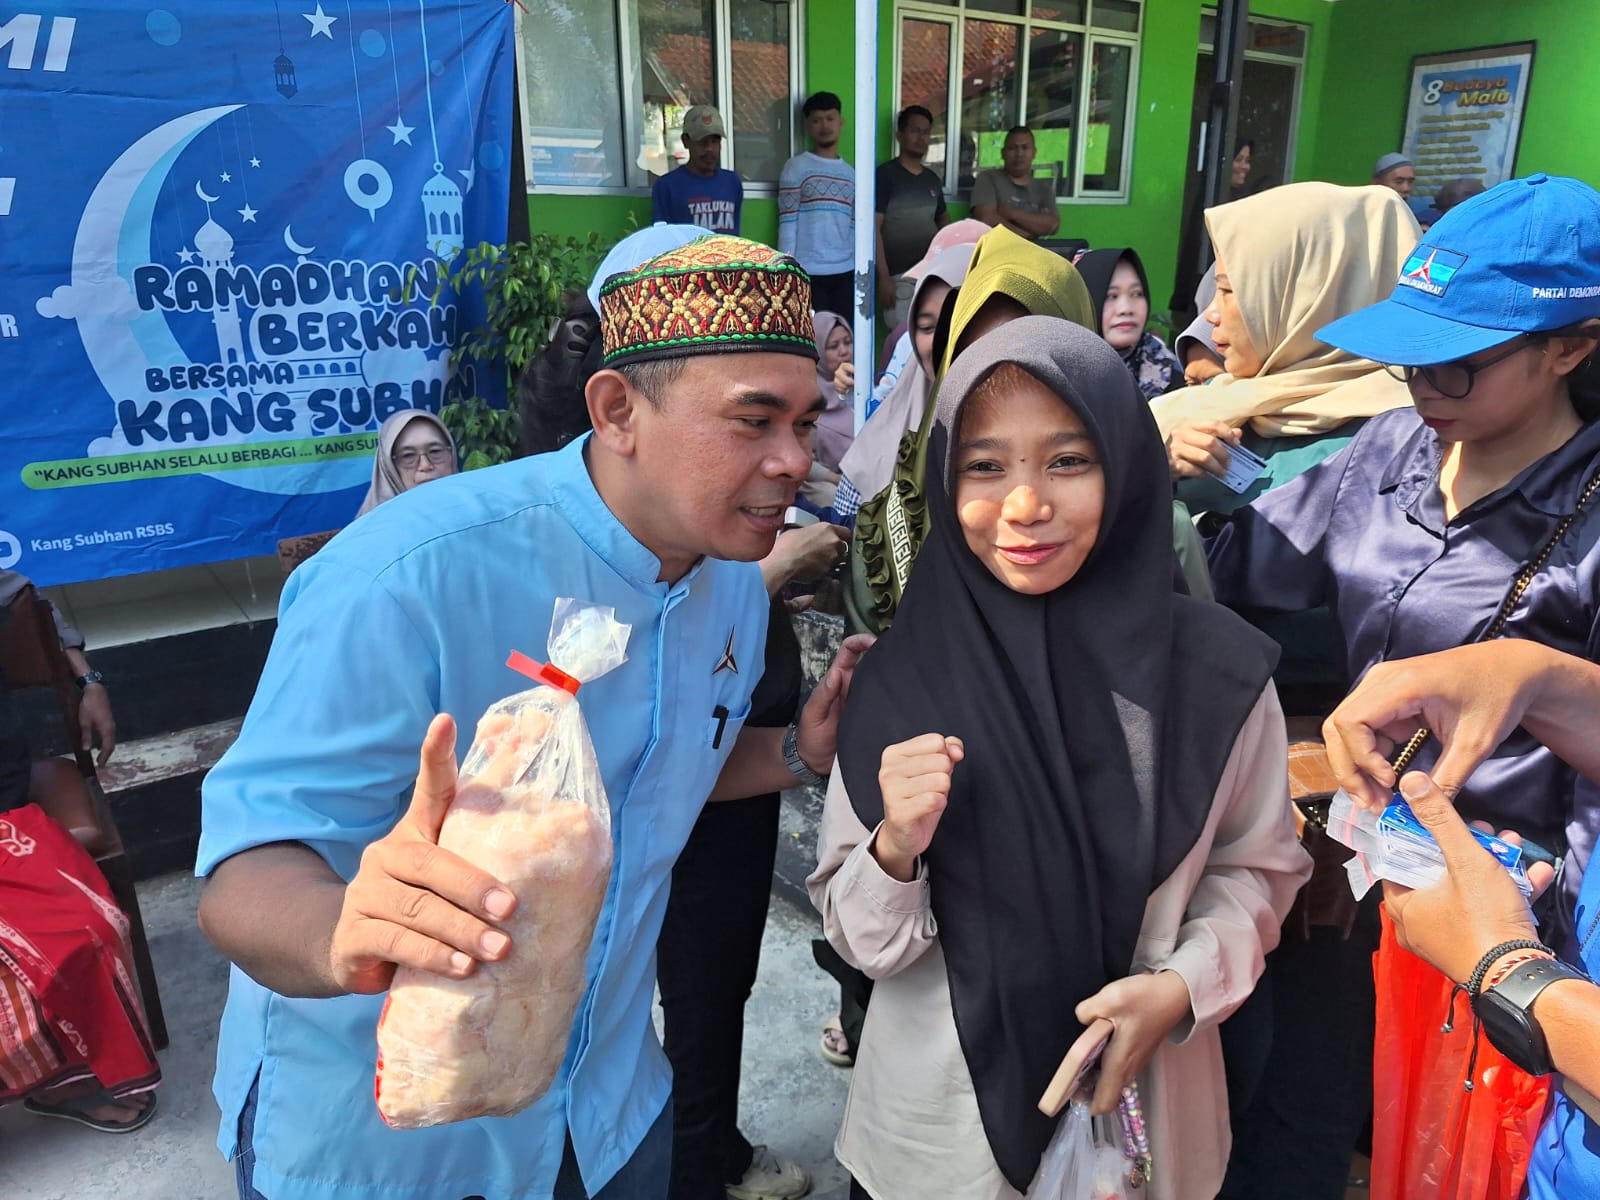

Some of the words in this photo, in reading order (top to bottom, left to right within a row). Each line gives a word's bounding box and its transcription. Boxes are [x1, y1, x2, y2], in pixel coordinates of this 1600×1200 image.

[1423, 79, 1445, 105] 8
[687, 200, 735, 215] TAKLUKAN
[132, 259, 439, 313] RAMADHAN
[1532, 287, 1567, 299] PARTAI
[257, 306, 456, 356] BERKAH
[144, 362, 295, 393] BERSAMA
[118, 390, 297, 447] KANG
[96, 457, 167, 477] SUBHAN
[168, 448, 229, 469] SELALU
[231, 446, 297, 463] BERBAGI
[314, 440, 355, 456] KANG
[31, 538, 74, 552] Kang
[74, 529, 134, 547] Subhan
[135, 522, 175, 539] RSBS
